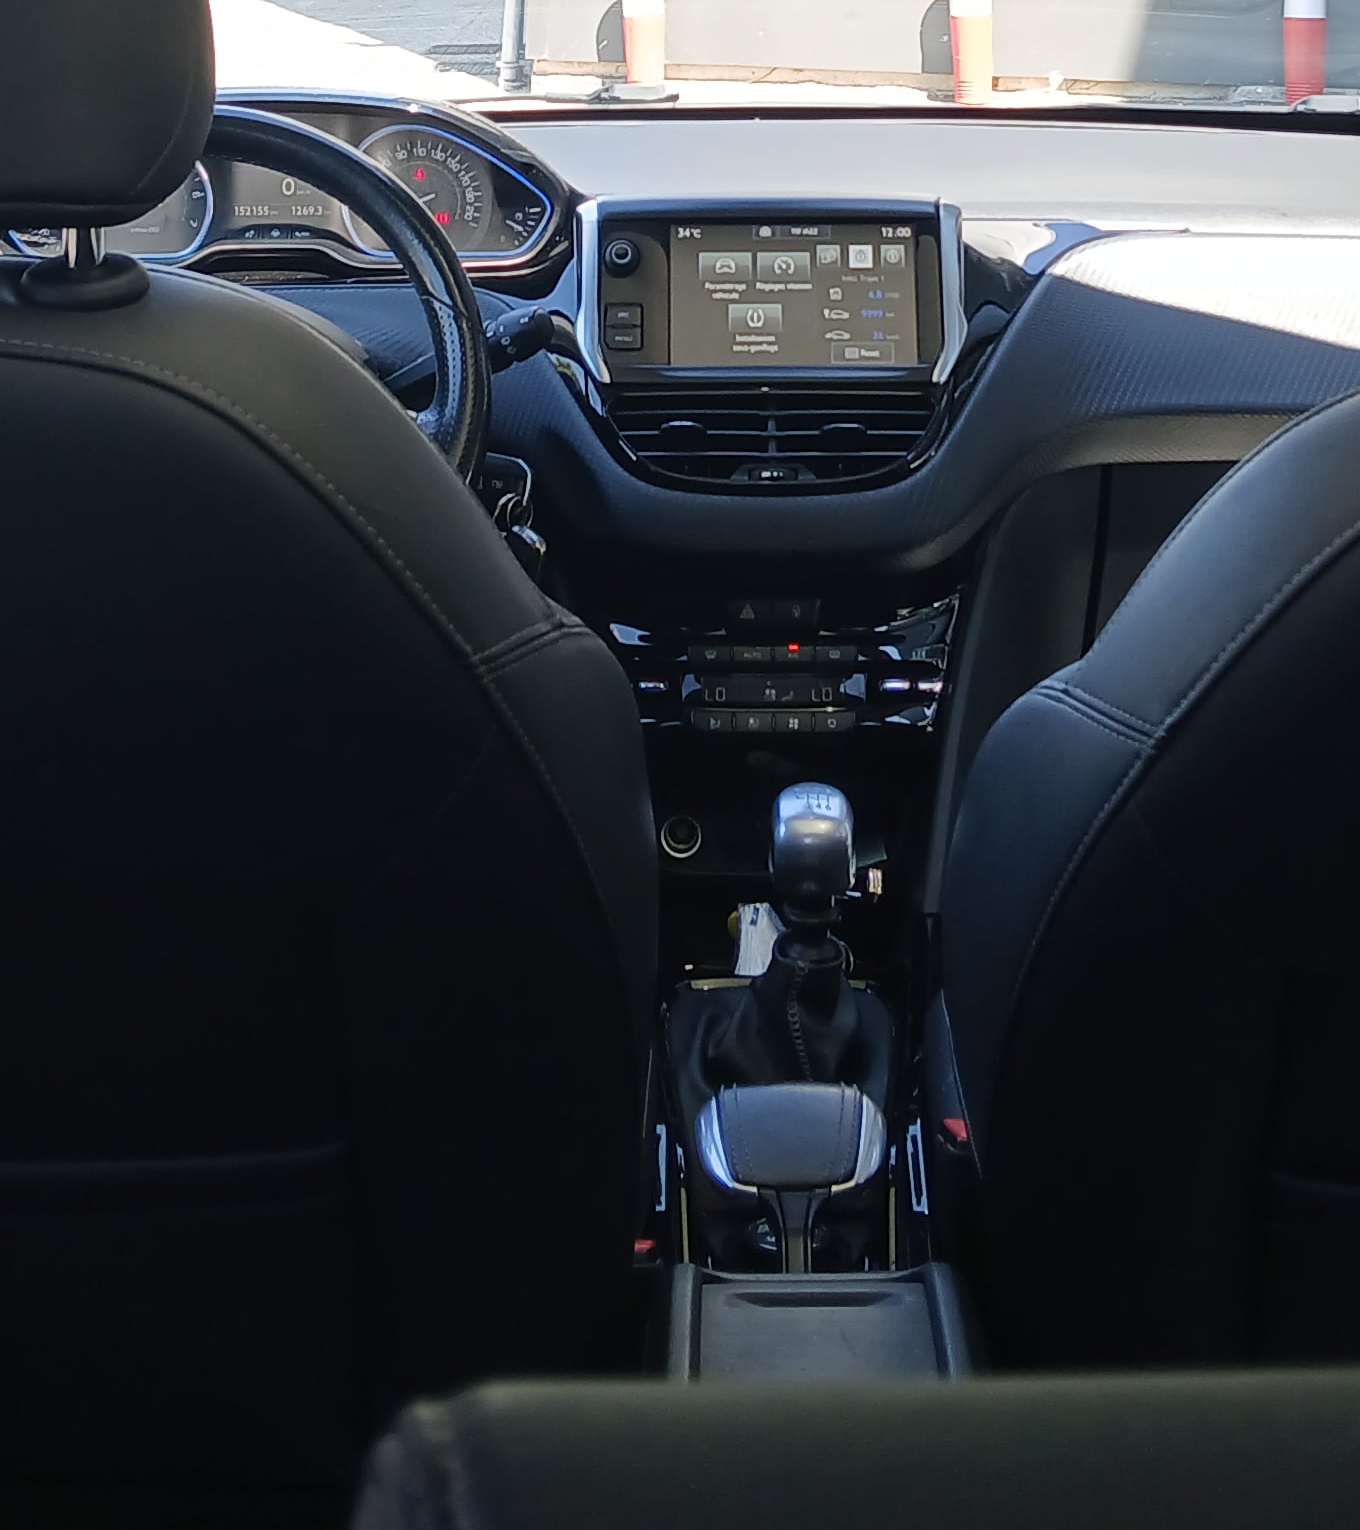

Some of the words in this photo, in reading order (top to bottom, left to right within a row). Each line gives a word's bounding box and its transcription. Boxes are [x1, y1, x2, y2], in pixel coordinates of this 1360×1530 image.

[281, 178, 295, 196] 0
[234, 205, 269, 216] 152155
[291, 206, 322, 216] 1269.3
